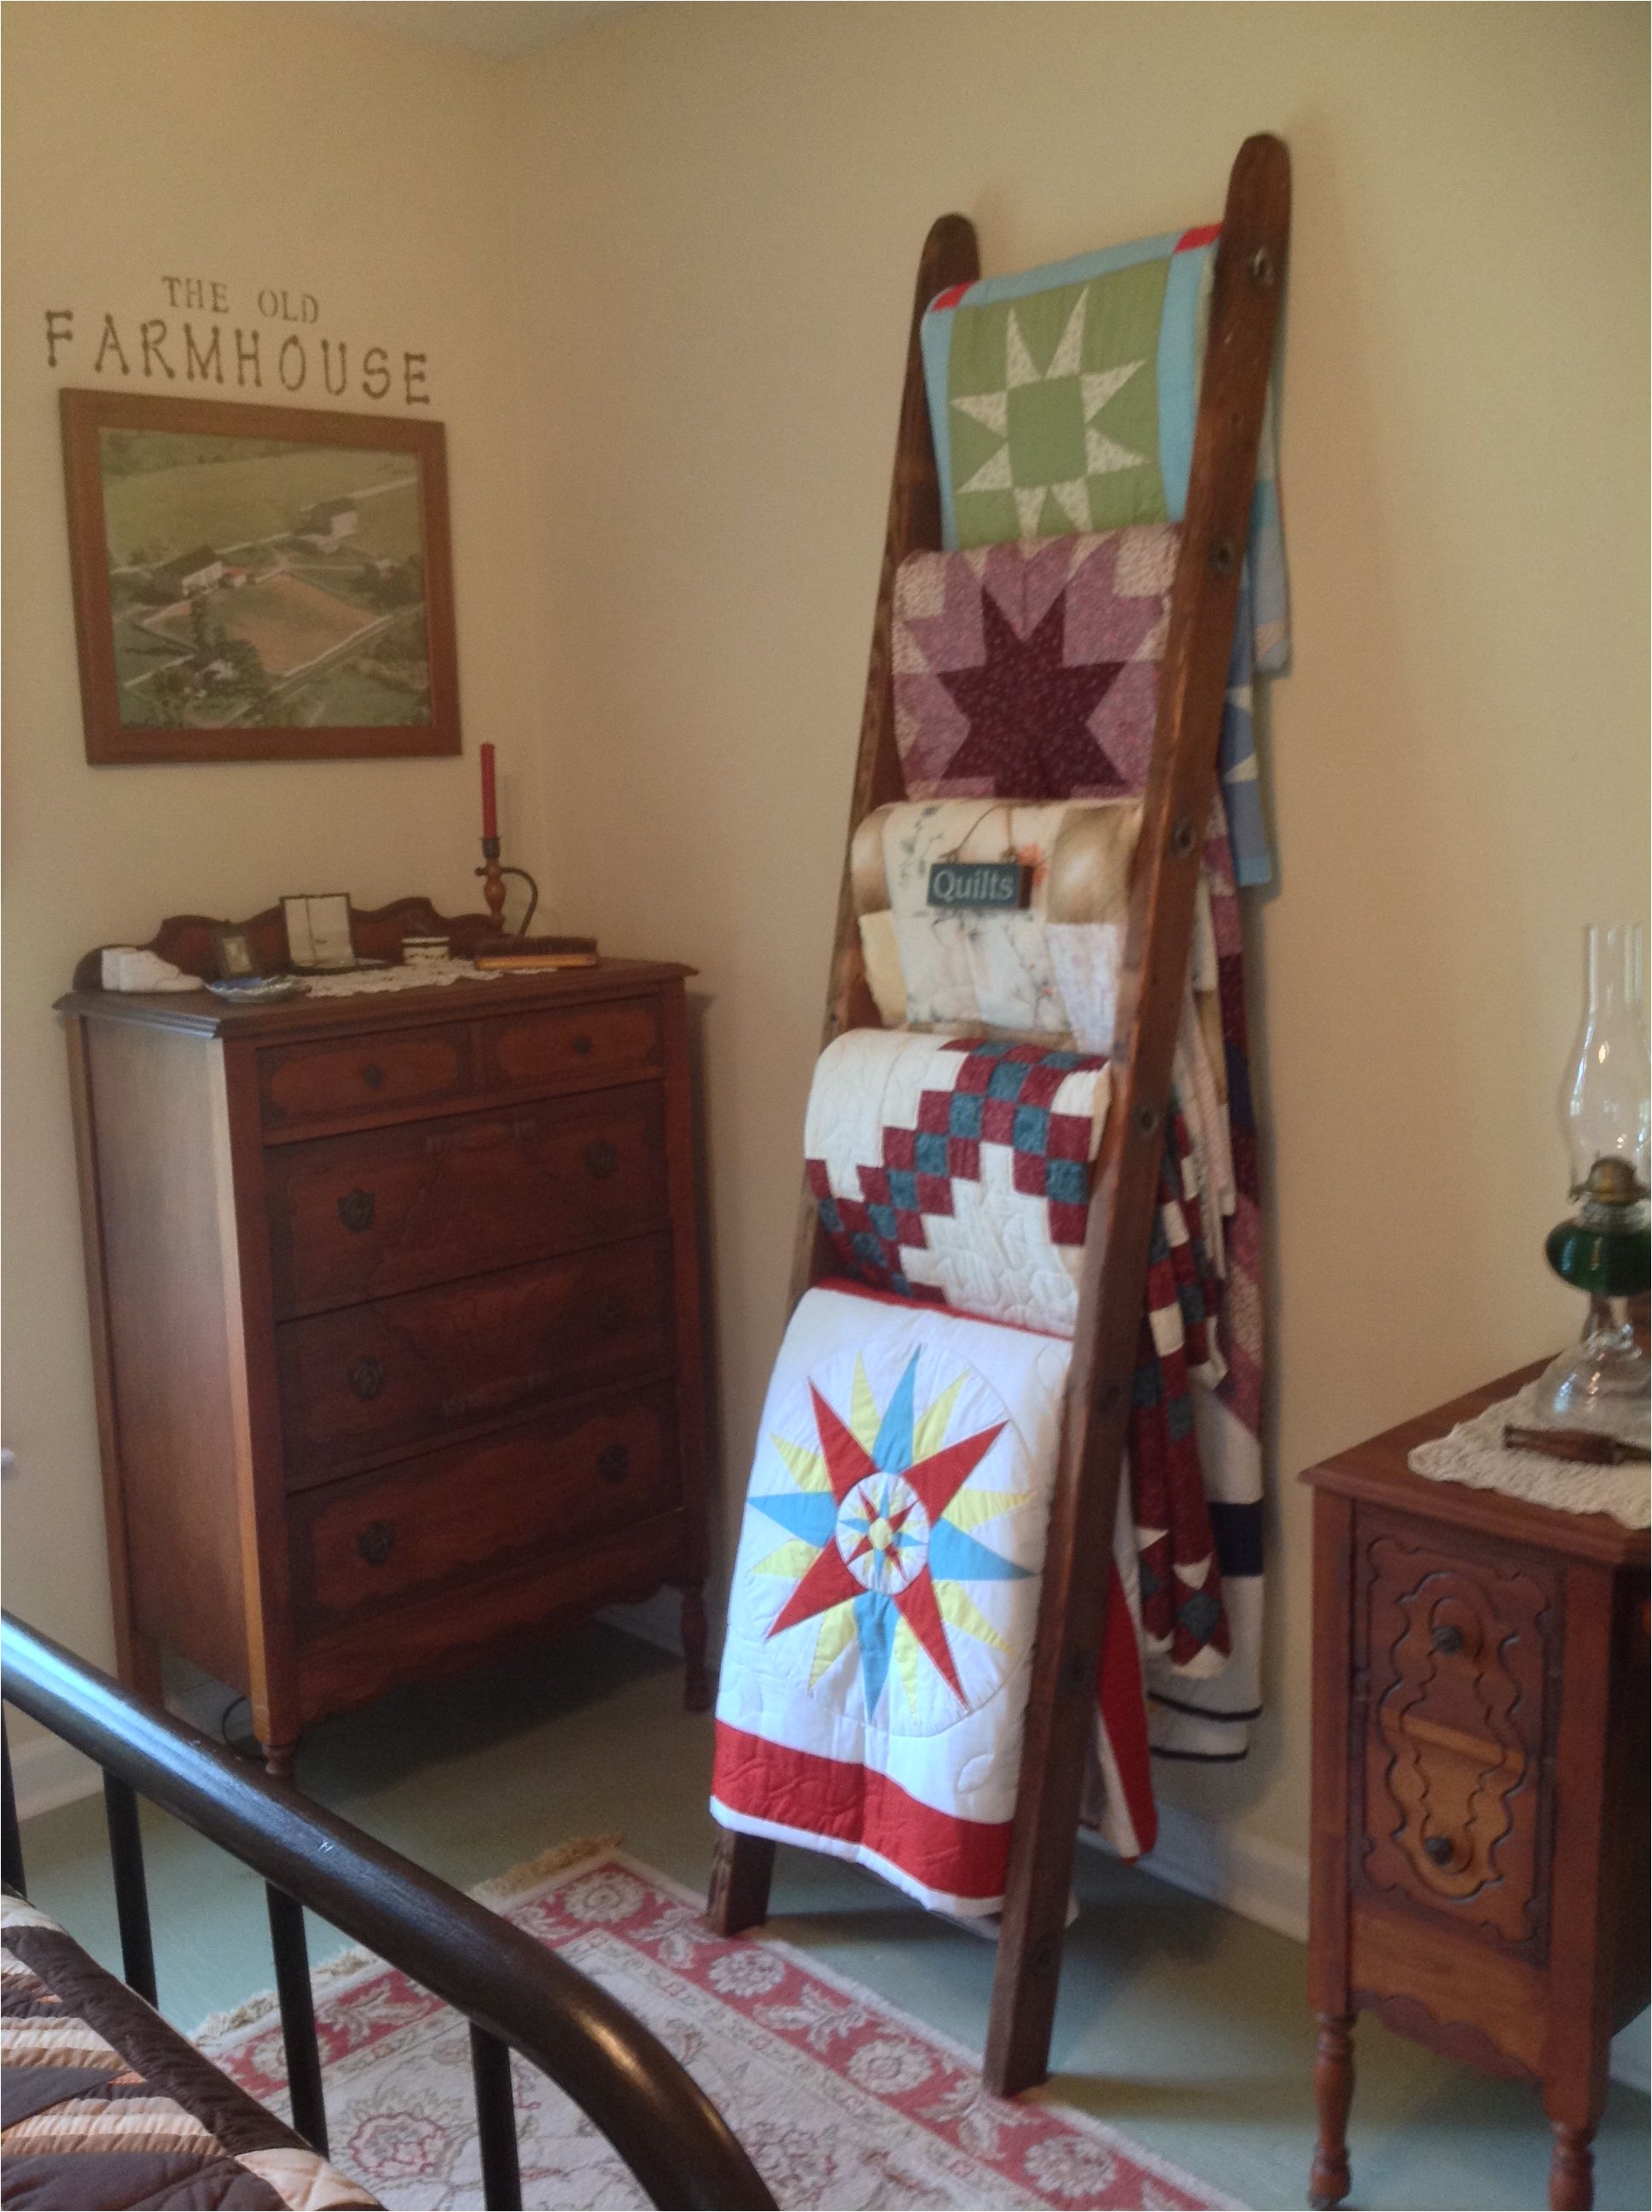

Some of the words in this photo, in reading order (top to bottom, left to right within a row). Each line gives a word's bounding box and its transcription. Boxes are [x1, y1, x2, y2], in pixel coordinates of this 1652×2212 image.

[161, 276, 230, 314] THE
[258, 289, 319, 323] OLD
[44, 309, 430, 405] FARMHOUSE
[934, 868, 1014, 903] Quilts
